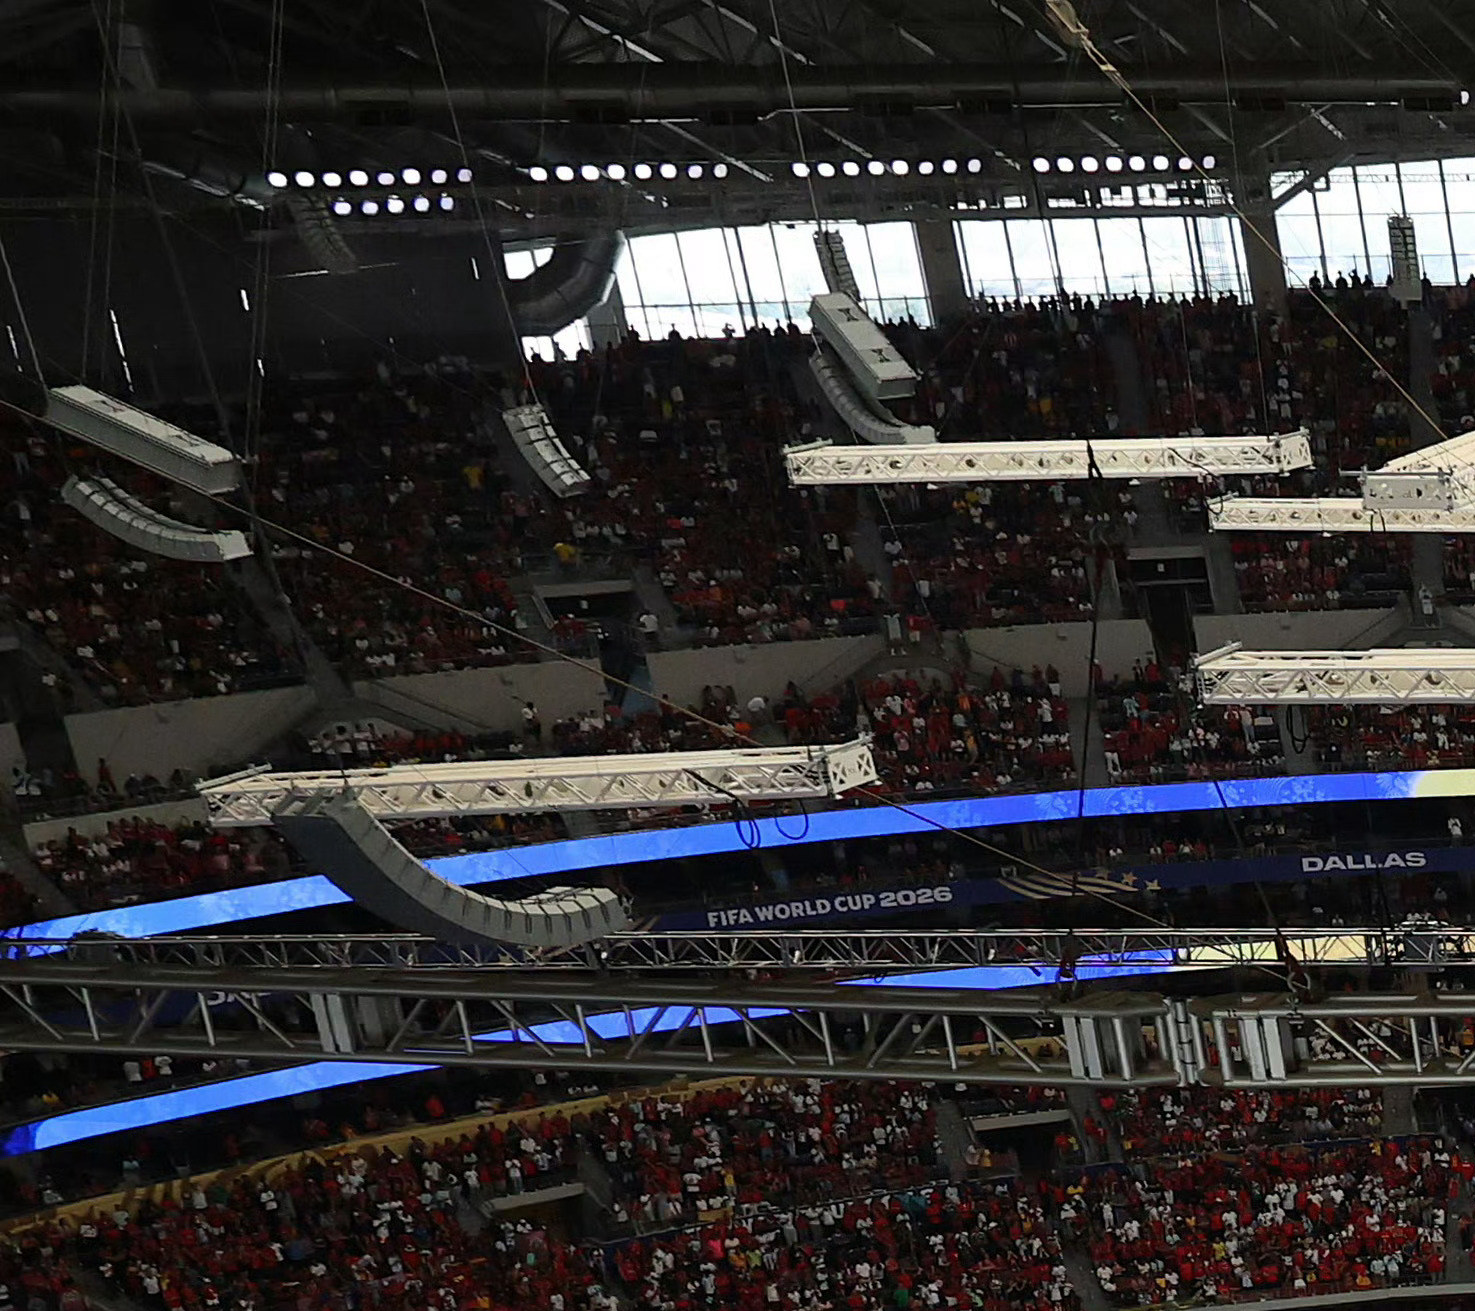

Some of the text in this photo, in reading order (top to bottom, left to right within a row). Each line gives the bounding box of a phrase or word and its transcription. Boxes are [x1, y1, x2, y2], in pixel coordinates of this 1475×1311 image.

[1302, 852, 1427, 872] DALLAS
[707, 886, 953, 928] FIFA WORLD CUP 2026
